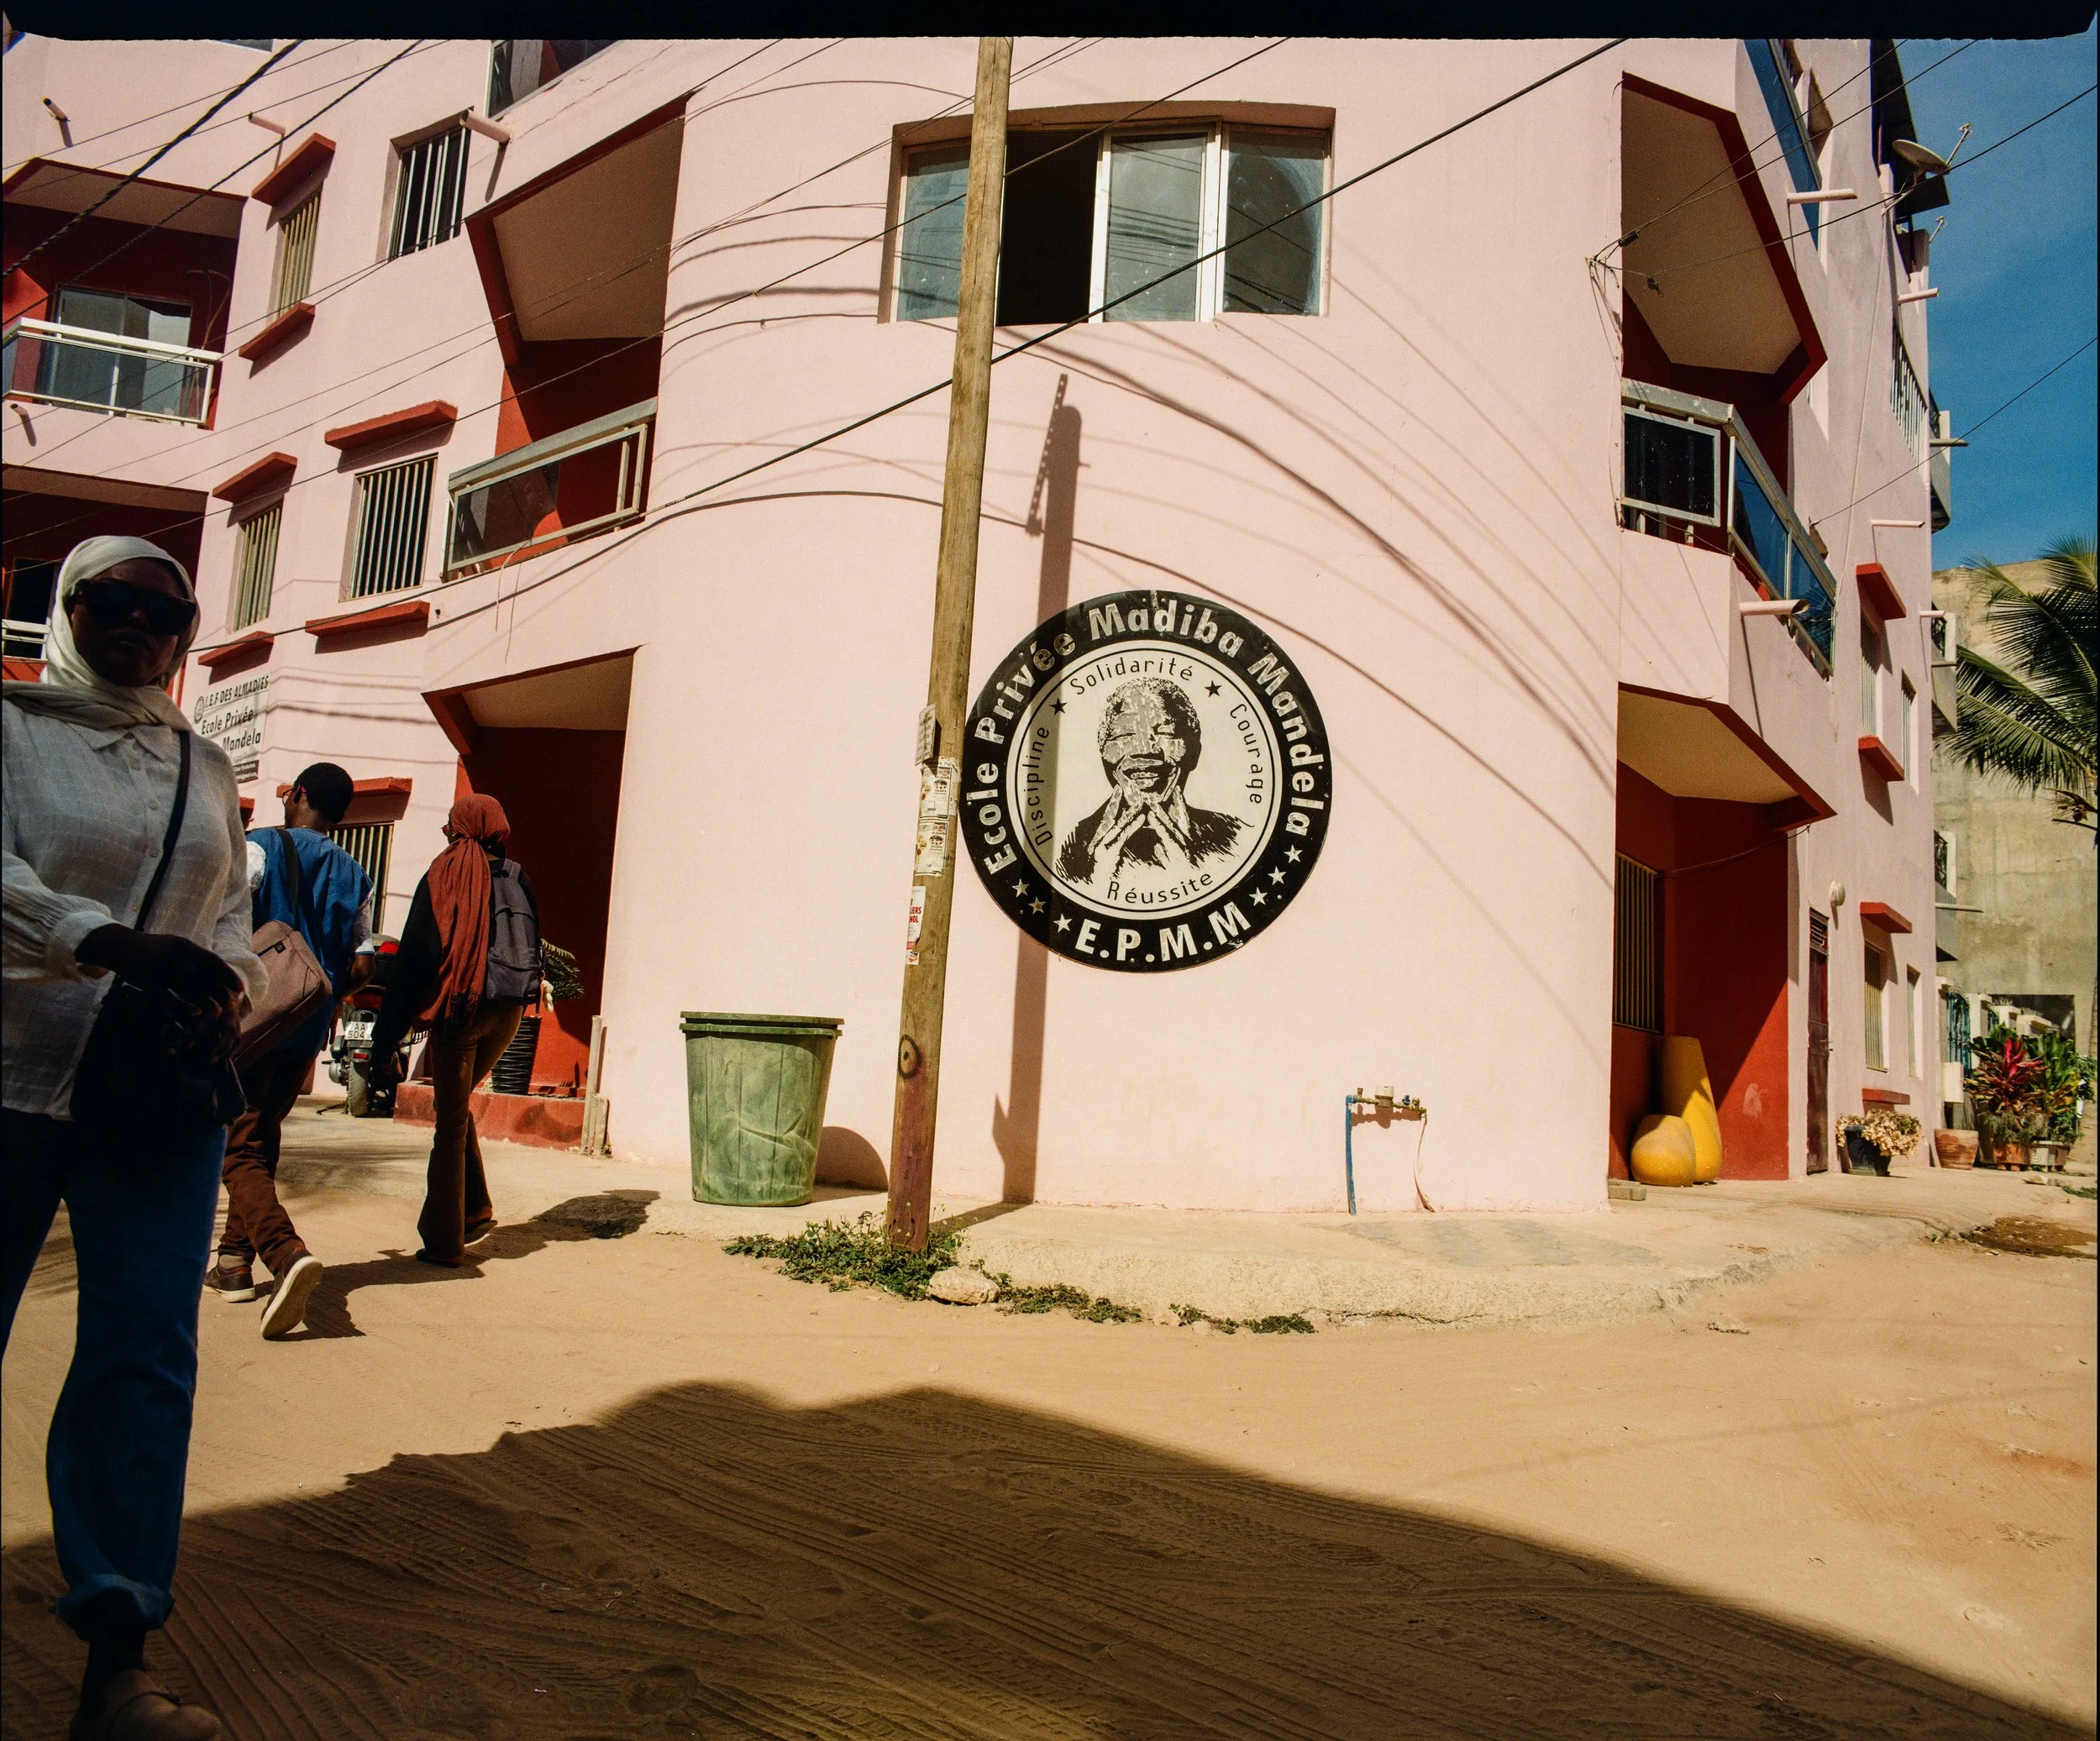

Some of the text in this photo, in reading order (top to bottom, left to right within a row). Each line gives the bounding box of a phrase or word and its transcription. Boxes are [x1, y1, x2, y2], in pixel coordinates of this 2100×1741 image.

[1089, 600, 1244, 658] Madiba
[220, 688, 232, 703] DES
[234, 676, 269, 697] ALMADIES
[974, 632, 1075, 745] Privée
[1070, 657, 1193, 695] Solidarité
[202, 706, 254, 735] Ecole Privée
[223, 728, 260, 751] Mandela
[1247, 652, 1325, 836] Mandela
[1229, 704, 1263, 805] Courage
[1021, 726, 1053, 846] Discipline
[966, 762, 1017, 874] Ecole
[1107, 871, 1213, 905] Réussite
[1075, 901, 1251, 963] E.P.M.M
